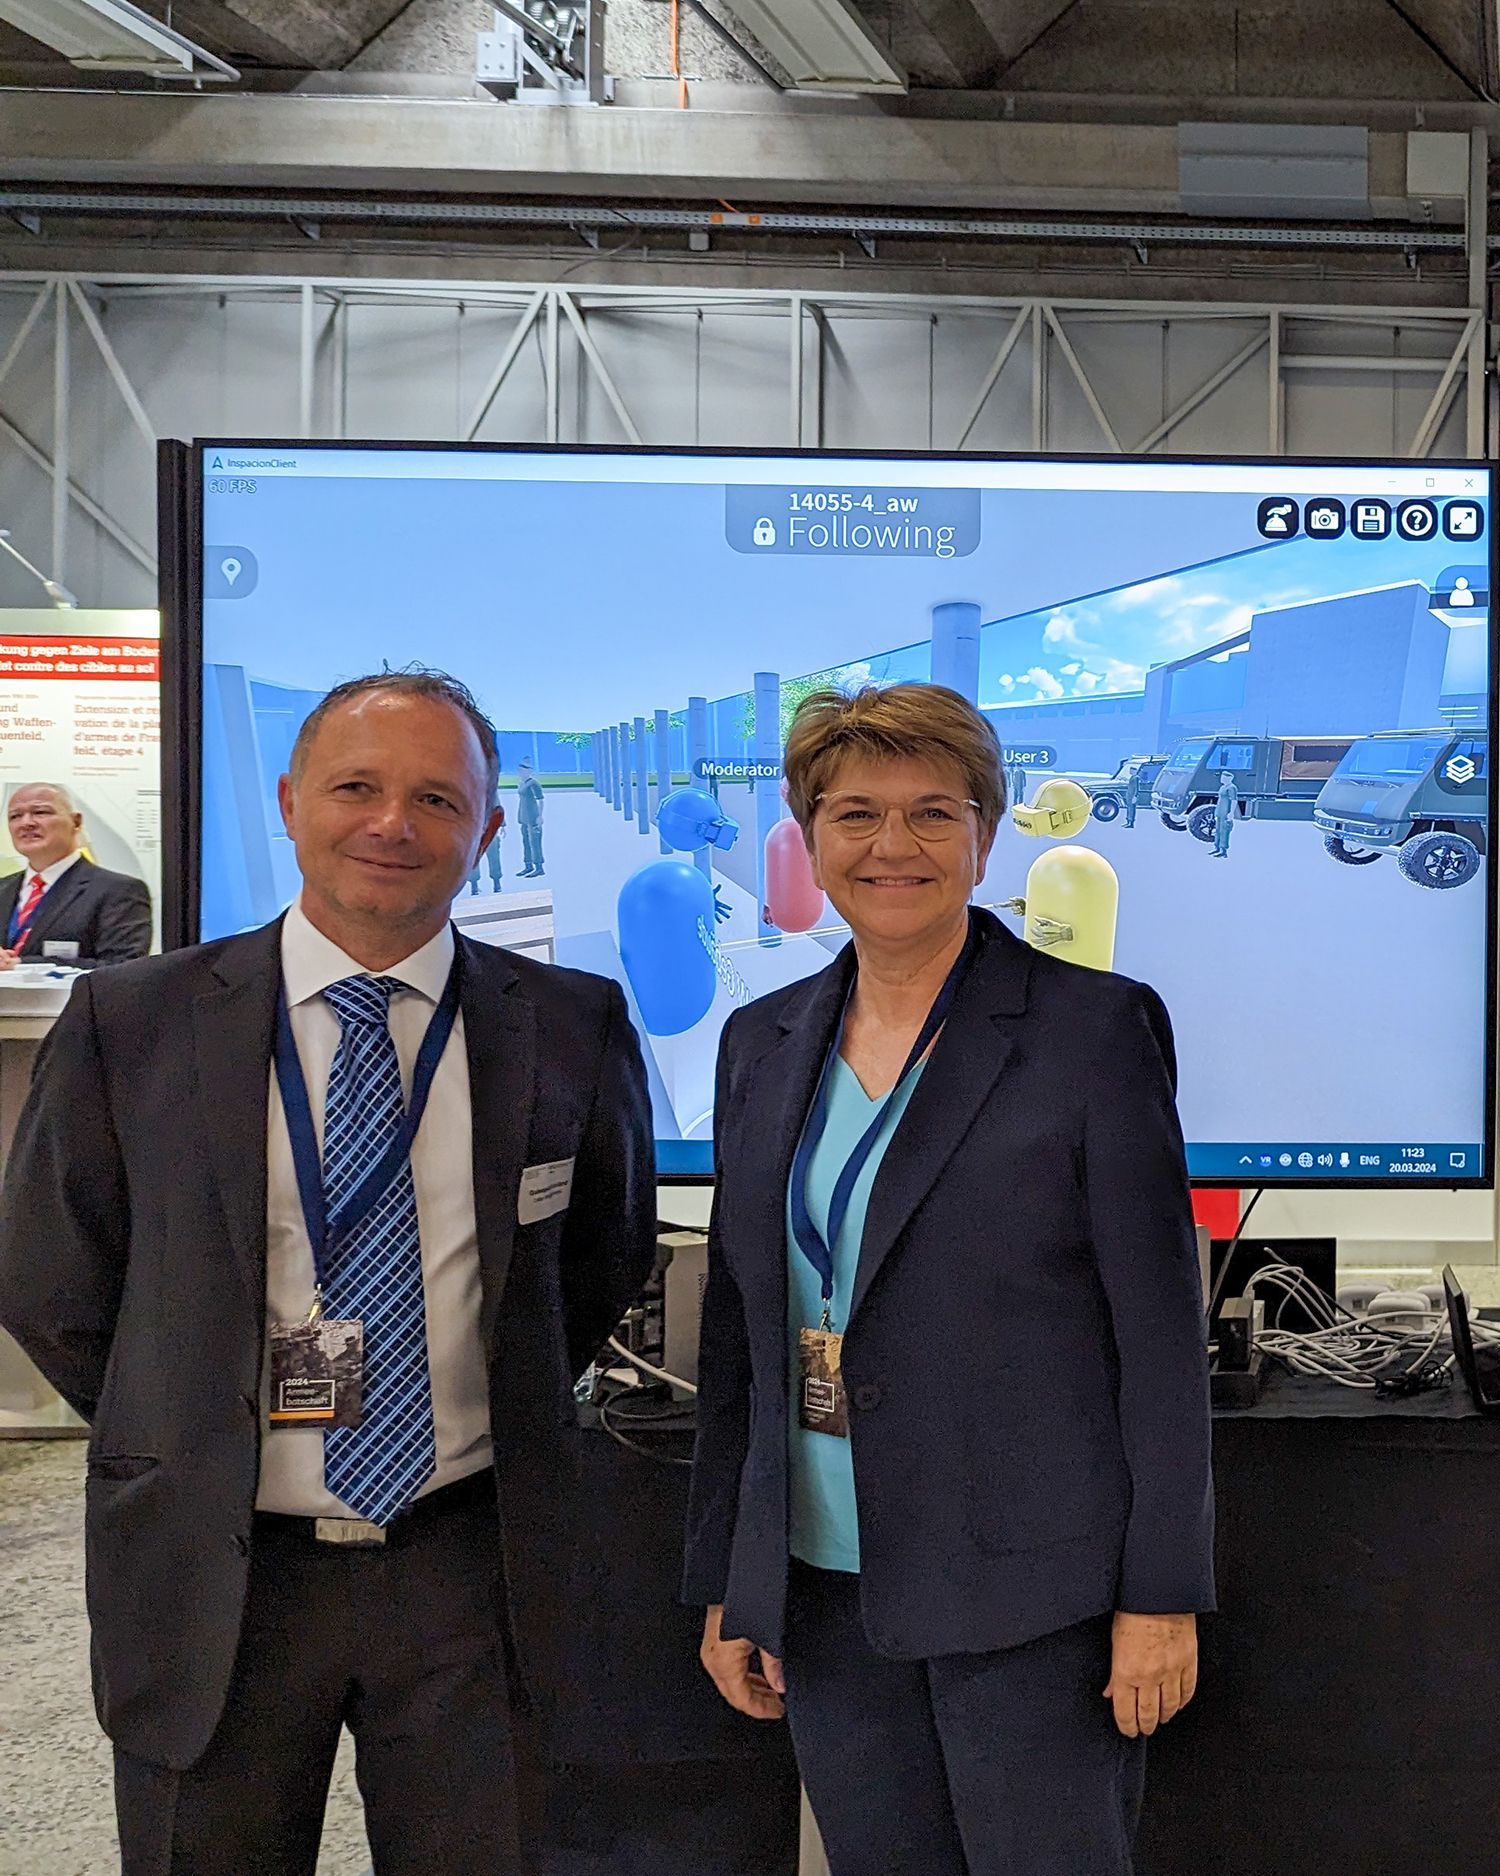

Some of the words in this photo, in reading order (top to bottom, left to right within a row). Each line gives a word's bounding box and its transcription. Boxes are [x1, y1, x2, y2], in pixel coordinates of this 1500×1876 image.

[227, 458, 297, 469] InspacionClient
[208, 479, 227, 494] 60
[229, 479, 257, 494] FPS
[789, 493, 919, 515] 14055-4_aw
[789, 515, 956, 559] Following
[74, 704, 129, 714] Extension
[1004, 749, 1038, 763] User
[1039, 750, 1049, 764] 3
[701, 762, 780, 777] Moderator
[1401, 1148, 1425, 1158] 11:23
[1360, 1155, 1380, 1165] ENG
[1389, 1163, 1436, 1173] 20.03.2024
[285, 1378, 308, 1386] 2024
